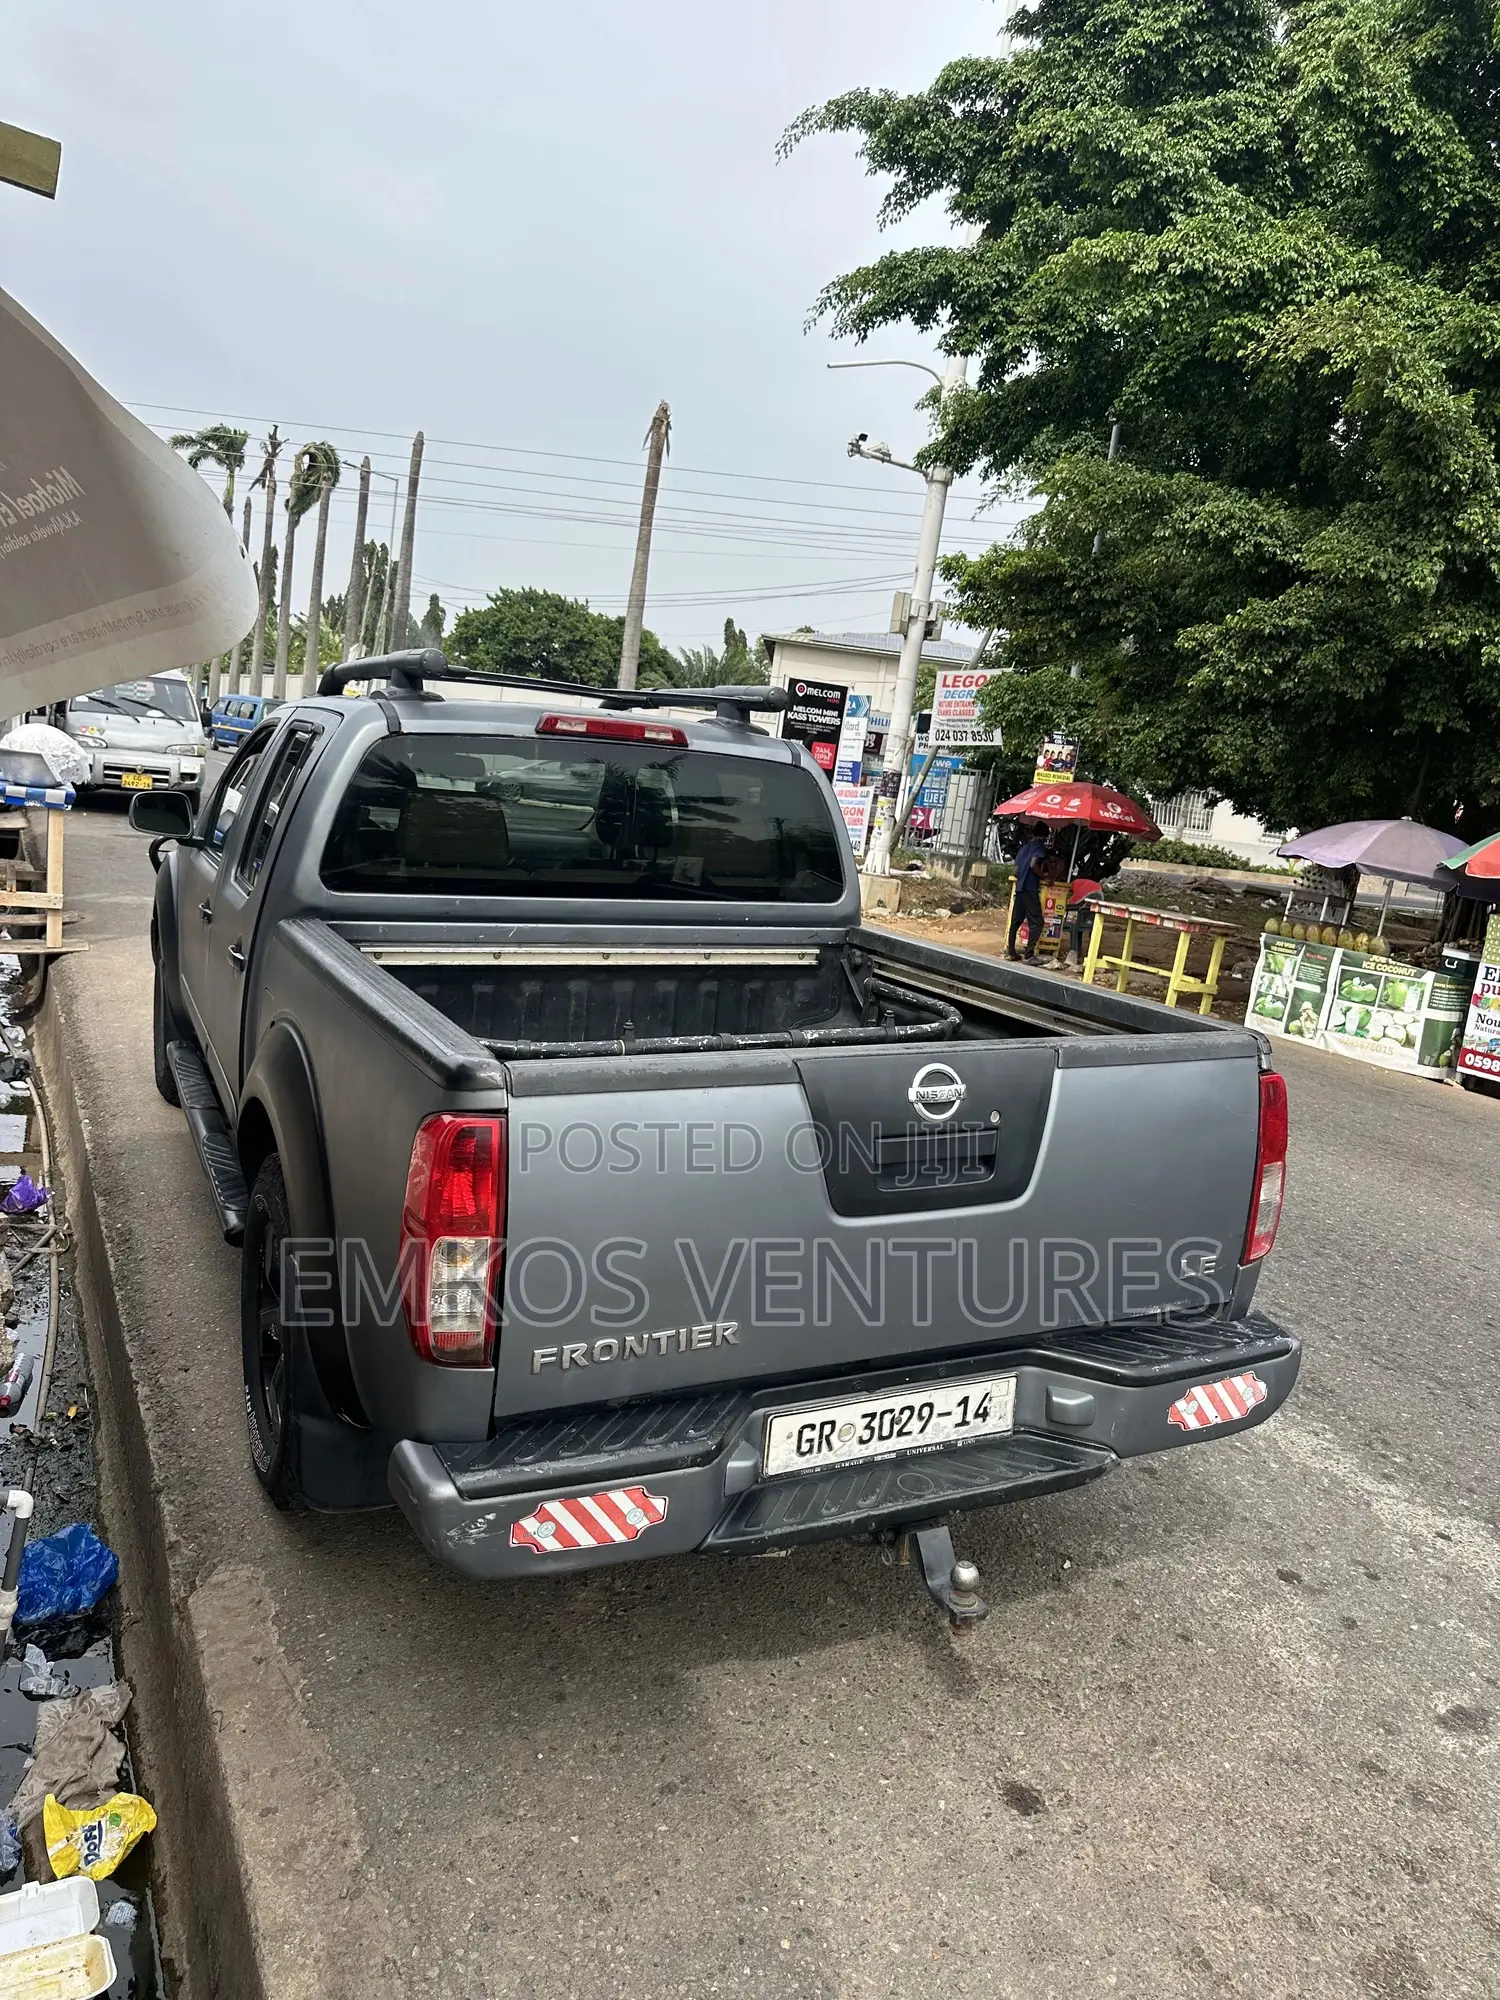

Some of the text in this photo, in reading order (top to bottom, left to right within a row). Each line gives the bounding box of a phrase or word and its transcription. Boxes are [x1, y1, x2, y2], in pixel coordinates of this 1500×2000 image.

[807, 687, 841, 700] MELCOM
[793, 705, 839, 717] MELCOM MINI
[952, 709, 975, 717] CLASSES
[787, 711, 841, 726] KASS TOWERS
[935, 729, 951, 741] 024
[953, 729, 968, 741] 037
[1099, 810, 1135, 823] telecel
[1362, 961, 1375, 970] ICE
[1376, 963, 1417, 977] COCONUT
[915, 1087, 963, 1101] NISSAN
[1180, 1255, 1217, 1279] LE
[531, 1321, 741, 1375] FRONTIER
[796, 1391, 991, 1458] GR 3029-14
[906, 1444, 945, 1456] UNIVERSAL
